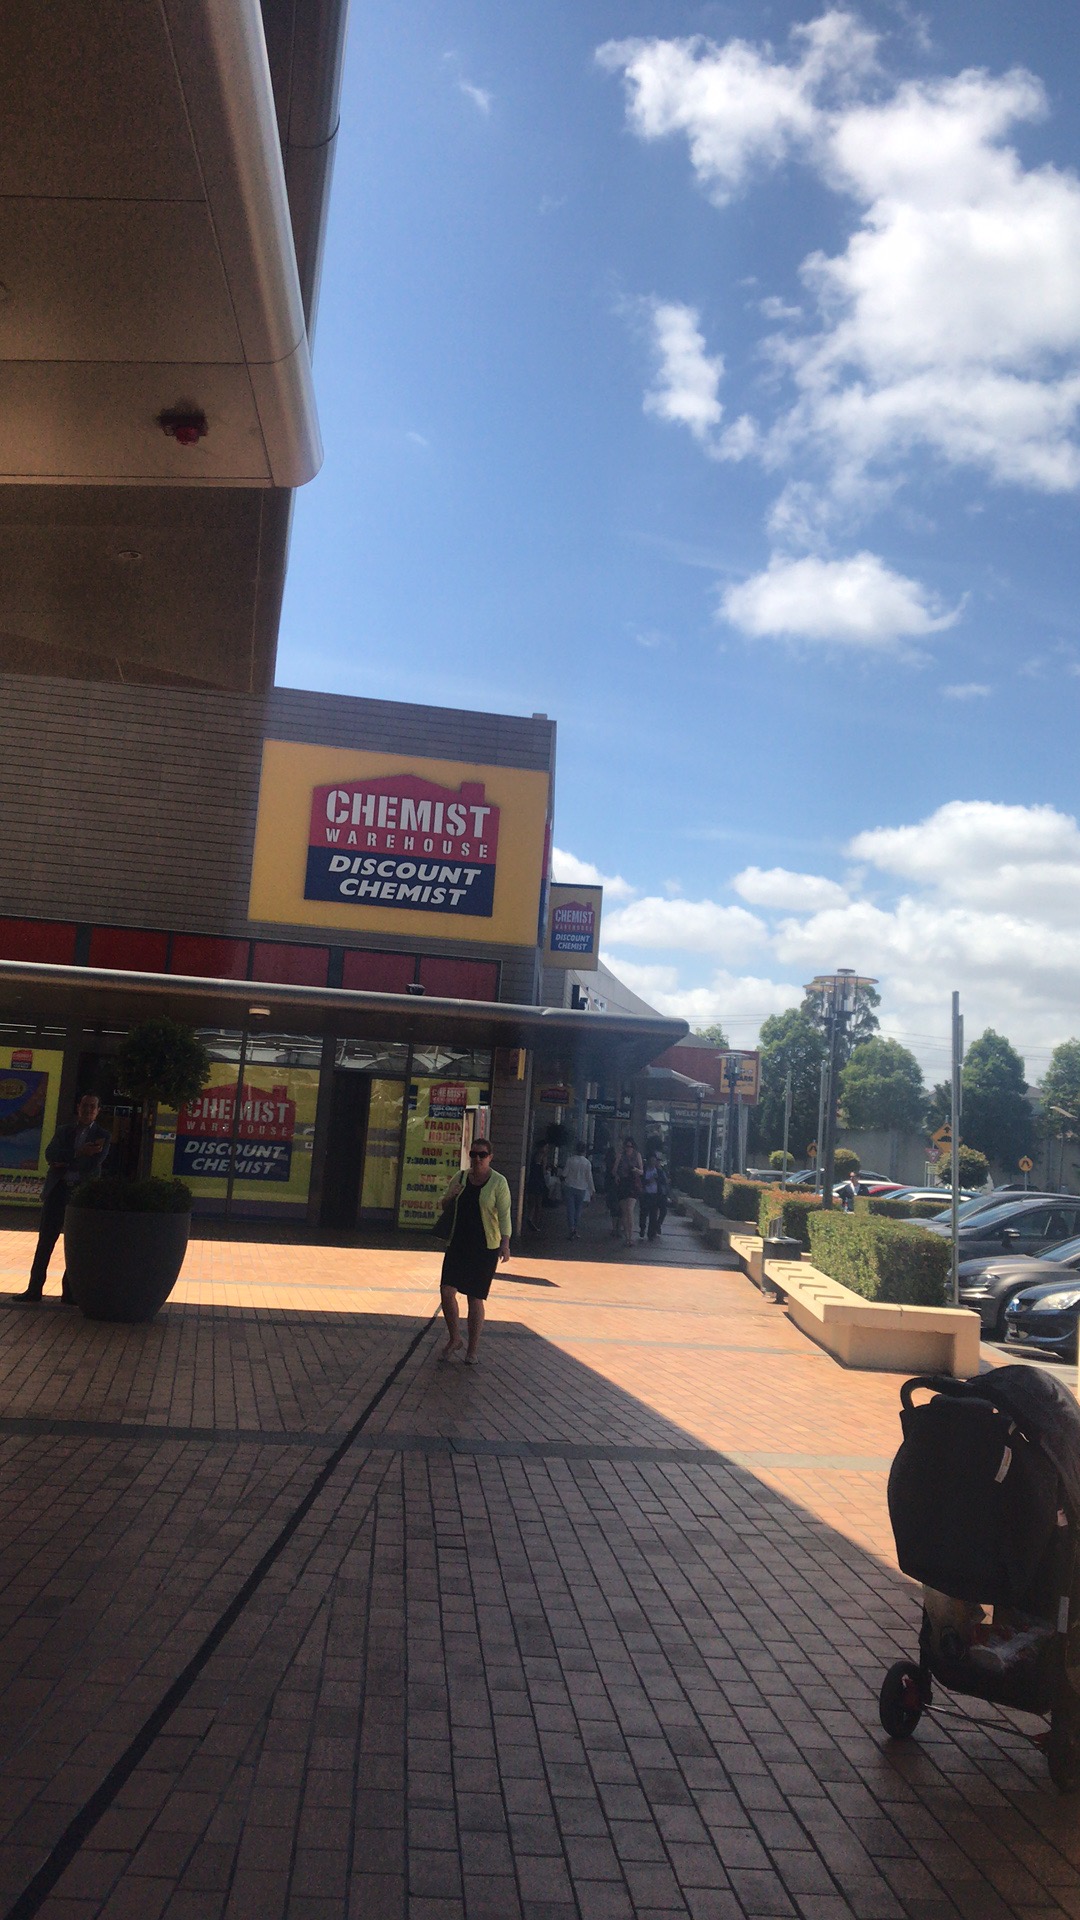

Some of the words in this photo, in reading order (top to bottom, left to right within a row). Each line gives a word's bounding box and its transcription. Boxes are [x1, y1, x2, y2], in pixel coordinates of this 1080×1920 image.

[326, 789, 491, 839] CHEMIST
[325, 827, 488, 859] WAREHOUSE
[328, 855, 482, 886] DISCOUNT
[339, 878, 467, 906] CHEMIST
[555, 909, 594, 924] CHEMIST
[555, 933, 591, 943] DISCOUNT
[557, 942, 588, 951] CHEMIST
[187, 1097, 289, 1123] CHEMIST
[425, 1120, 461, 1131] TRADIN
[184, 1140, 286, 1160] DISCOUNT
[191, 1157, 276, 1175] CHEMIST
